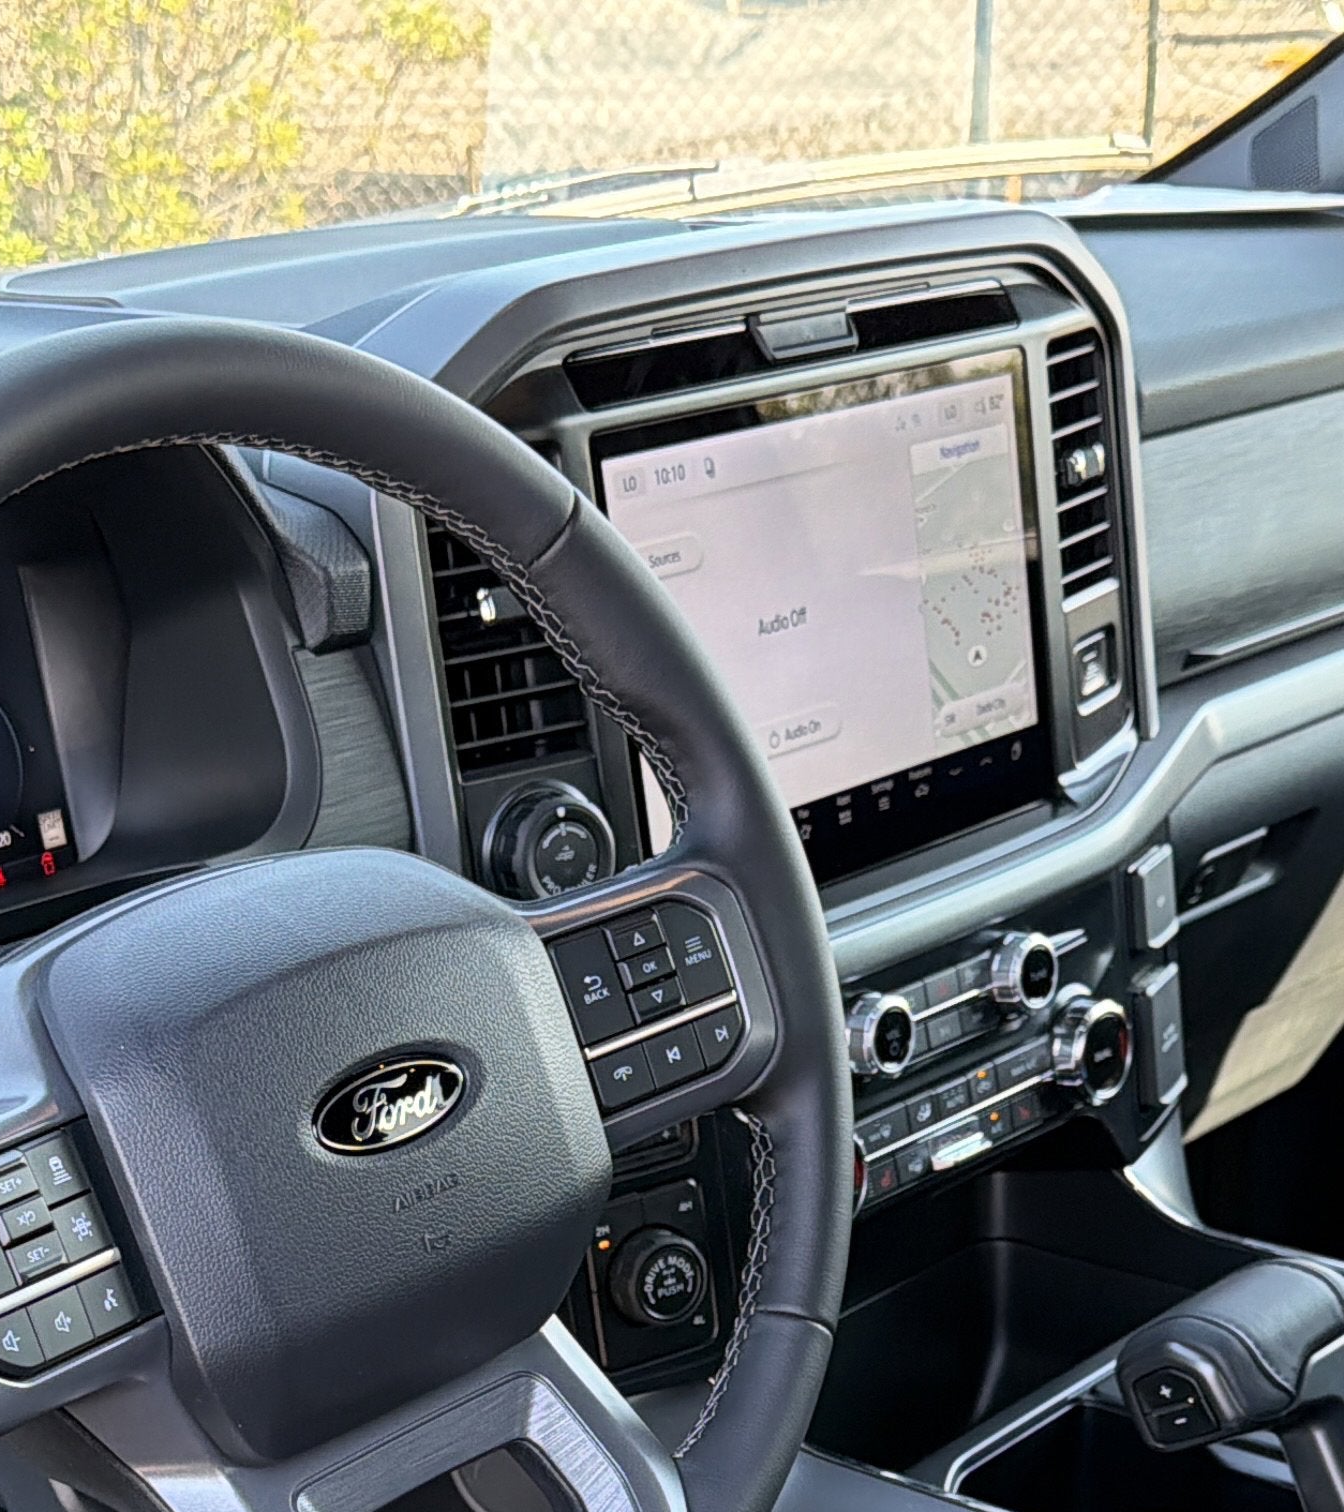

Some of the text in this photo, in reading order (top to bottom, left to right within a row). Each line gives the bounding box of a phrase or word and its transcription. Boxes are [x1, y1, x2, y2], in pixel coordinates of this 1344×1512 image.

[623, 464, 686, 493] LO 10:10
[648, 551, 681, 569] Sources
[758, 606, 807, 637] Audio Off
[784, 718, 822, 742] Audio On
[684, 949, 712, 966] MENU
[642, 962, 658, 974] OK
[584, 987, 610, 1005] BACK
[351, 1073, 438, 1142] Ford
[595, 1225, 611, 1238] 2H
[26, 1246, 51, 1263] SET-
[644, 1255, 695, 1293] DRIVE MODE
[657, 1283, 685, 1299] PUSH
